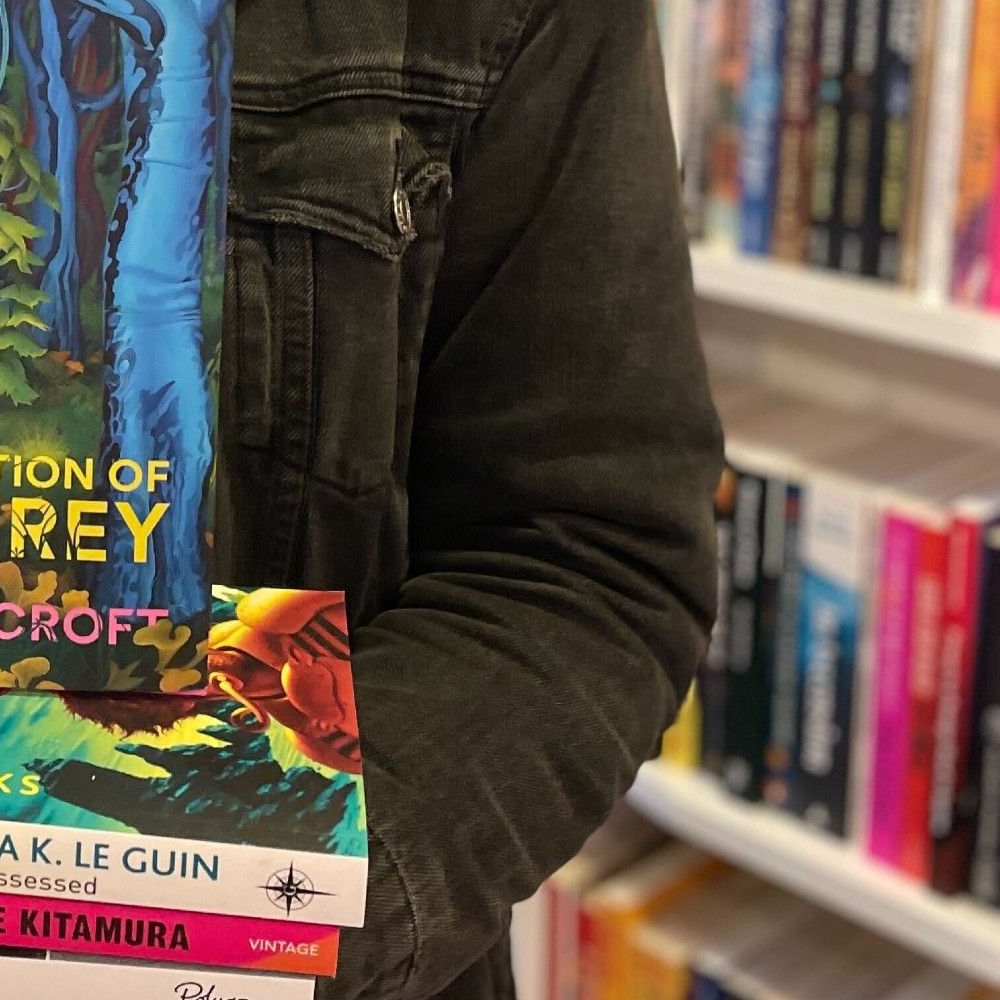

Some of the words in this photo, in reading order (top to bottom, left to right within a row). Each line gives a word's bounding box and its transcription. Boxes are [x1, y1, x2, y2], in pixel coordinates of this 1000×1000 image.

[108, 458, 170, 493] OF
[10, 496, 171, 563] REY
[32, 838, 61, 865] K.
[75, 844, 109, 870] LE
[122, 847, 220, 882] GUIN
[19, 909, 190, 951] KITAMURA
[249, 938, 320, 957] VINTAGE
